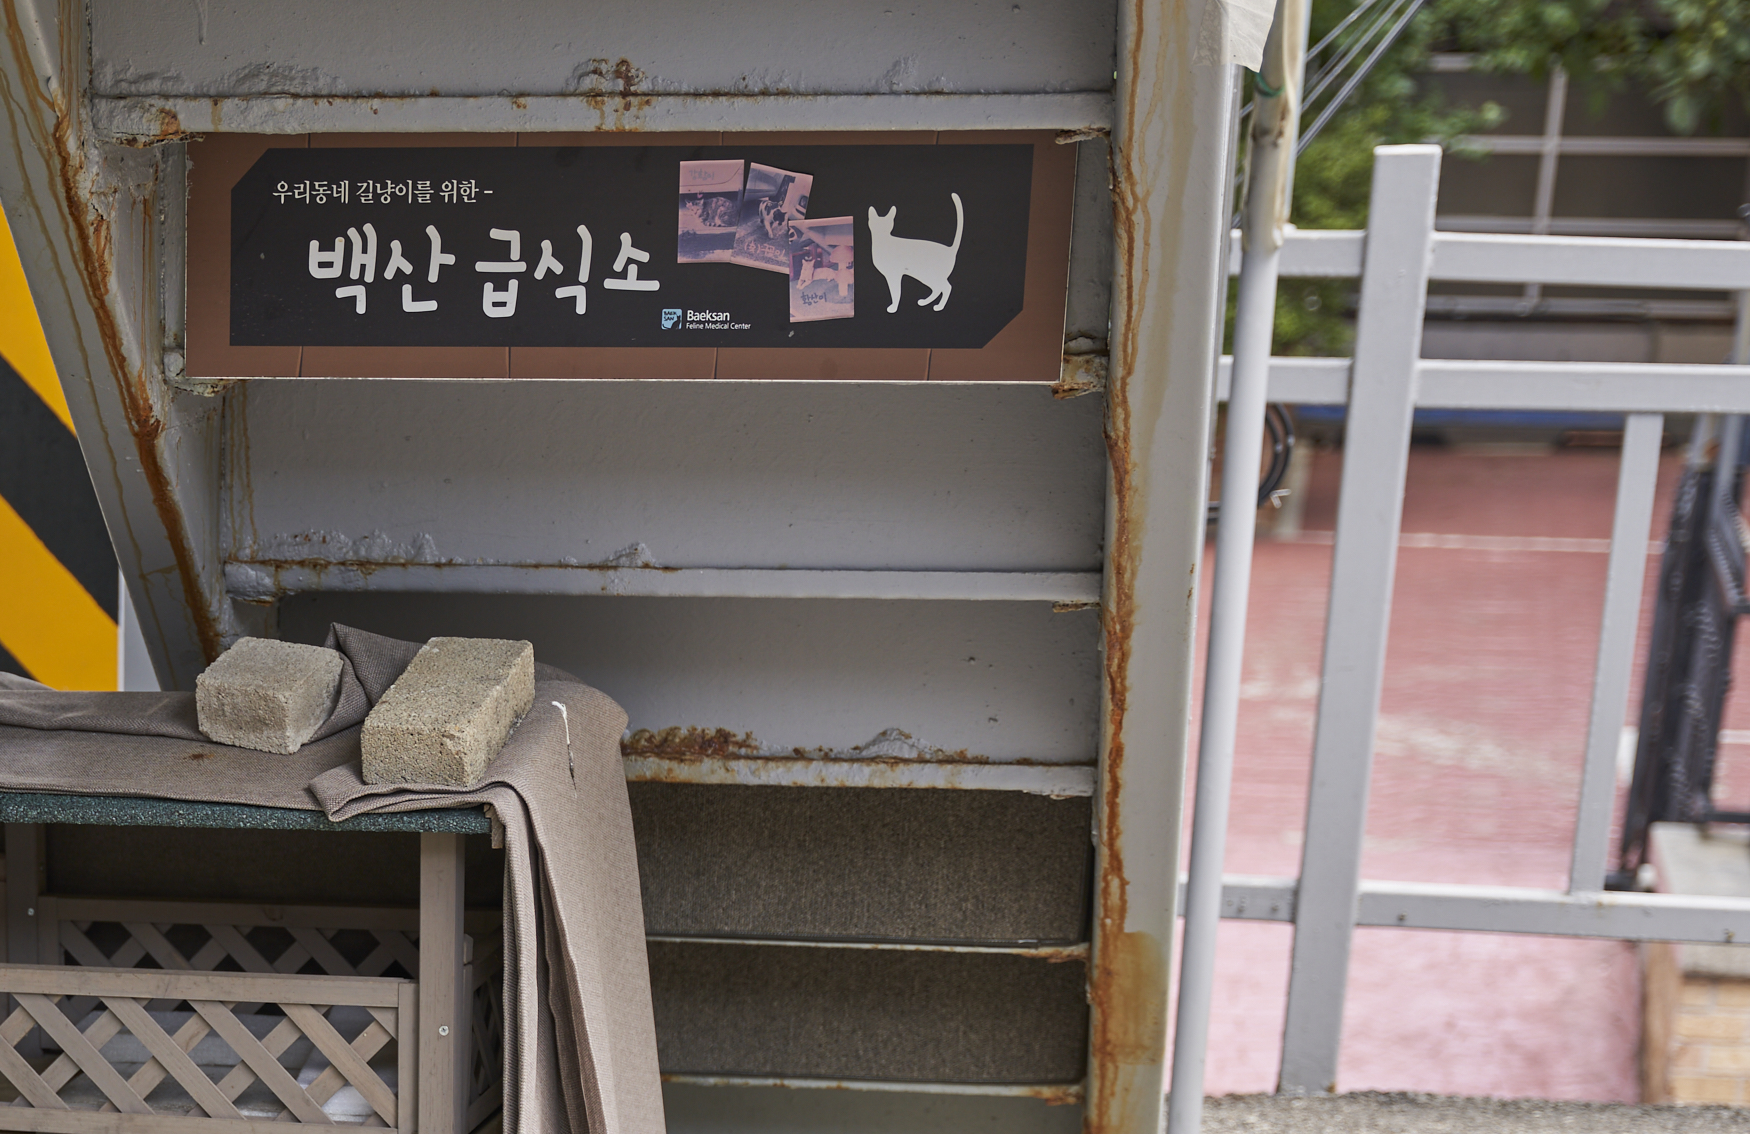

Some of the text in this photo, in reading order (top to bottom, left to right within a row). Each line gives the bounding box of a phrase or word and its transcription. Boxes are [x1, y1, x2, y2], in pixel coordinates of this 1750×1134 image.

[272, 179, 349, 204] 우리동네
[356, 179, 434, 204] 길냥이를
[308, 222, 660, 318] 백산 급식소
[687, 310, 730, 321] Baeksan
